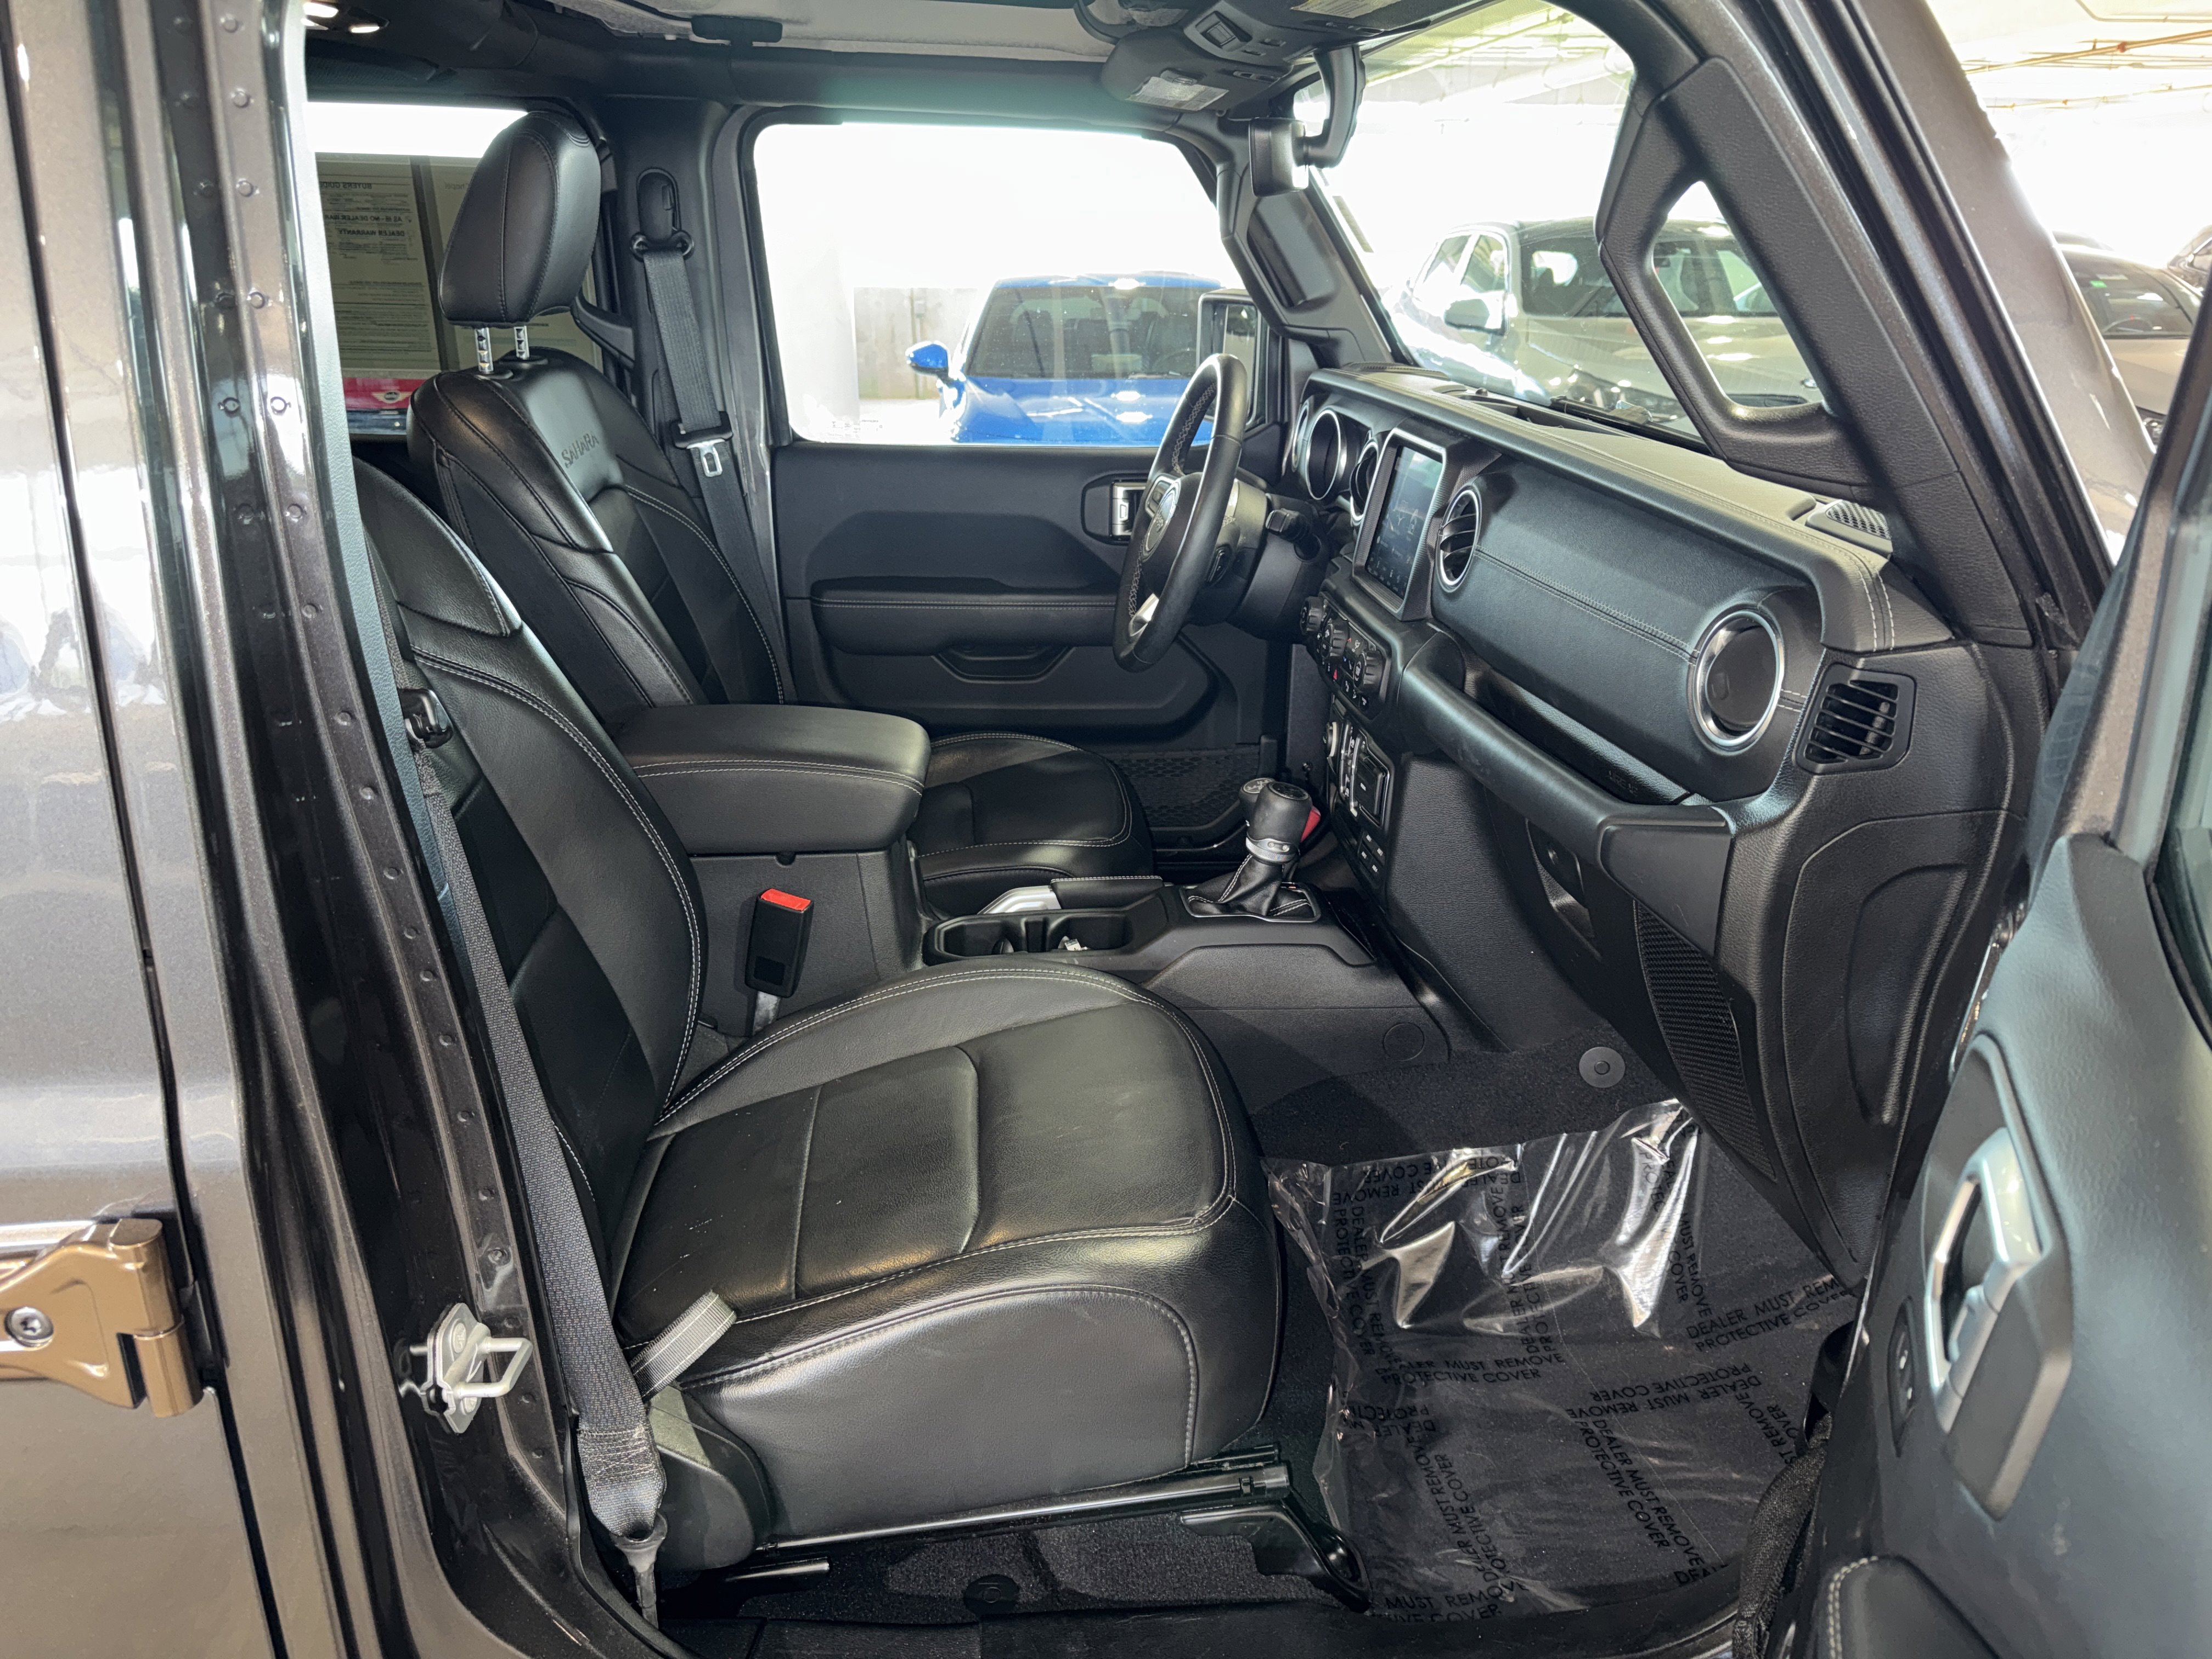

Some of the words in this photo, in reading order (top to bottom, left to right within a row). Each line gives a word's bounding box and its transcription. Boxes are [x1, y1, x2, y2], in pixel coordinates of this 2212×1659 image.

[561, 433, 600, 469] SAHARA
[1332, 1185, 1400, 1205] REMOVE
[1352, 1207, 1369, 1262] DEALER
[1491, 1187, 1511, 1251] REMOVE
[1679, 1213, 1695, 1250] MUST
[1334, 1209, 1360, 1301] PROTECTIVE
[1668, 1250, 1689, 1303] COVER
[1686, 1252, 1712, 1317] REMOVE
[1510, 1298, 1541, 1353] DEALER
[1686, 1309, 1748, 1339] DEALER
[1754, 1290, 1797, 1317] MUST
[1694, 1313, 1792, 1352] PROTECTIVE
[1380, 1371, 1479, 1385] PROTECTIVE
[1482, 1369, 1542, 1383] COVER
[1444, 1359, 1485, 1370] MUST
[1494, 1353, 1565, 1369] REMOVE
[1652, 1362, 1753, 1394] PROTECTIVE
[1589, 1385, 1650, 1402] COVER
[1647, 1392, 1690, 1410] MUST
[1698, 1375, 1762, 1400] DEALER
[1351, 1404, 1430, 1421] PROTECTI
[1565, 1401, 1640, 1419] REMOVE
[1735, 1392, 1787, 1447] REMOVE
[1767, 1404, 1799, 1438] OVER
[1407, 1436, 1446, 1495] REMOVE
[1435, 1454, 1469, 1502] COVER
[1575, 1421, 1635, 1497] PROTECTIVE
[1628, 1499, 1671, 1549] COVER
[1593, 1419, 1633, 1466] DEALER
[1626, 1470, 1660, 1504] MUST
[1650, 1506, 1705, 1566] REMOVE
[1436, 1498, 1466, 1534] MUST
[1460, 1505, 1506, 1570] OTECTIVE
[1385, 1595, 1434, 1610] MUST
